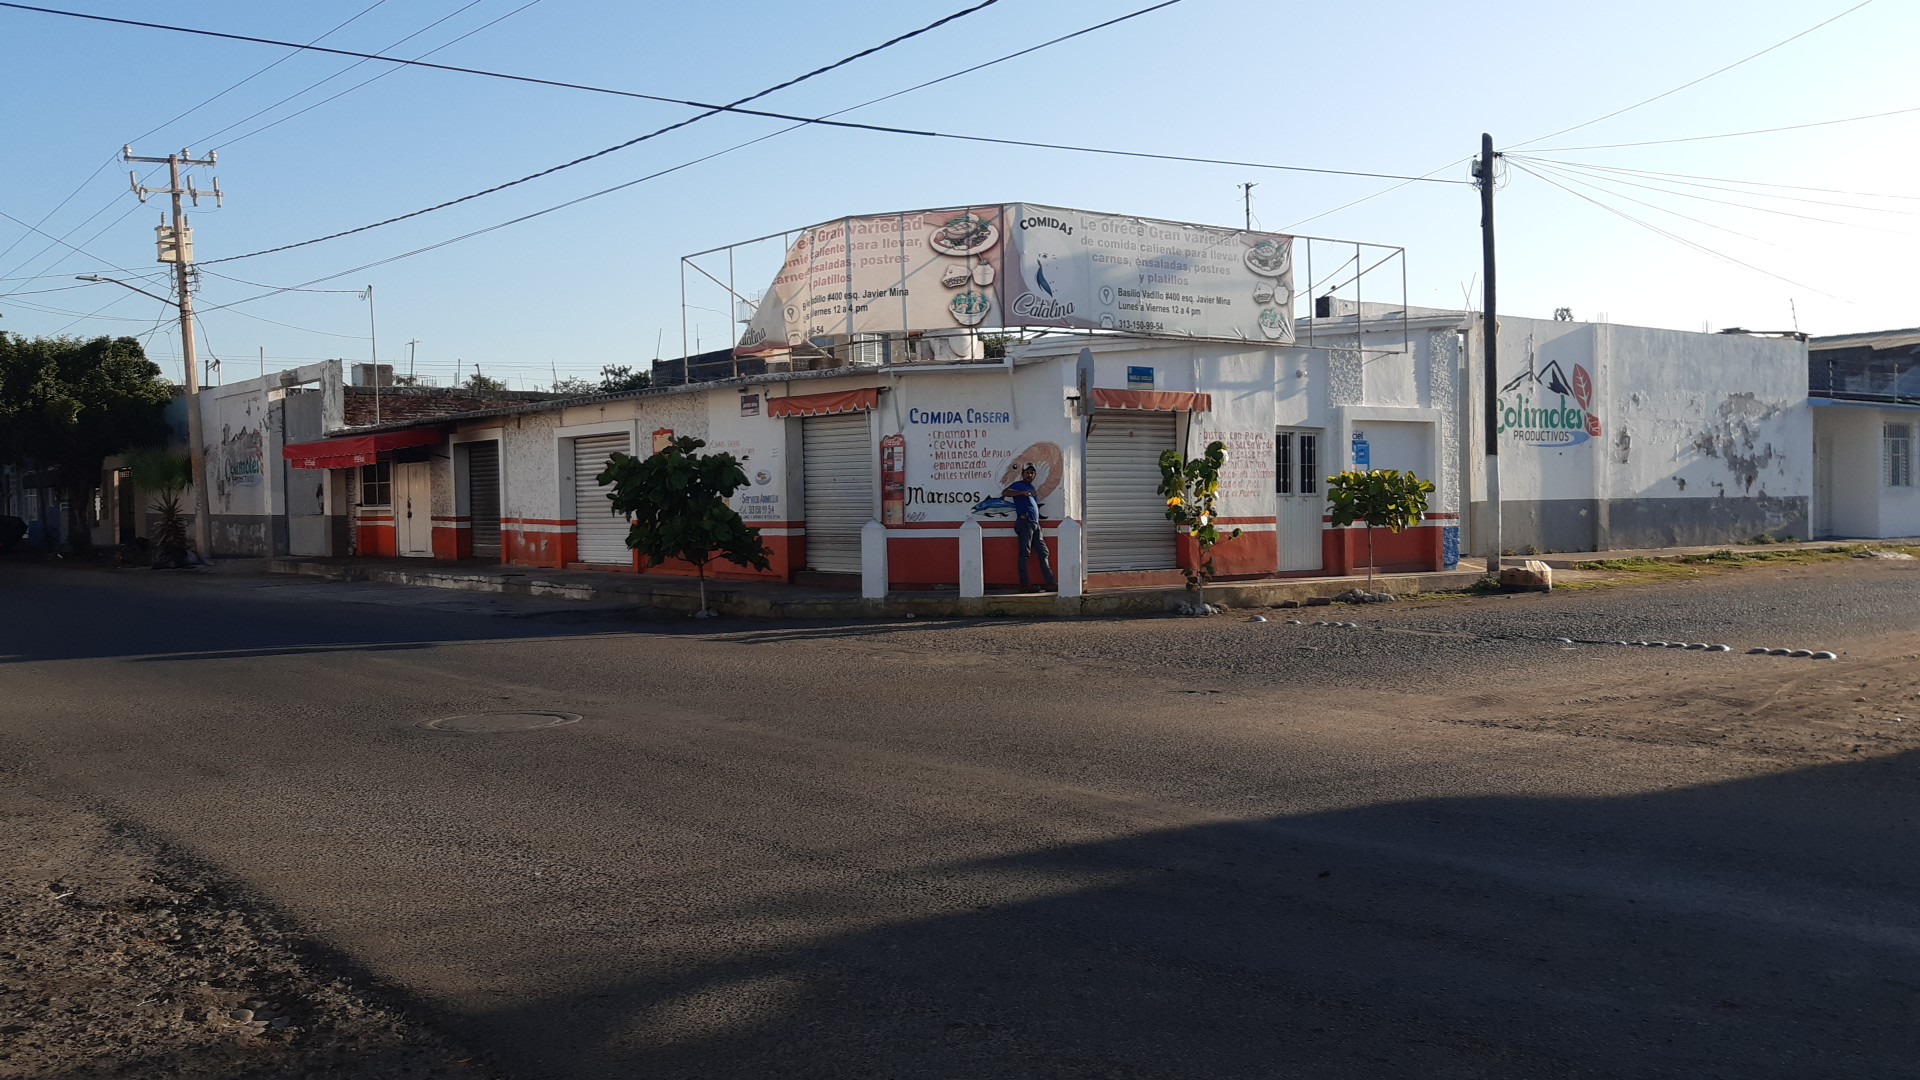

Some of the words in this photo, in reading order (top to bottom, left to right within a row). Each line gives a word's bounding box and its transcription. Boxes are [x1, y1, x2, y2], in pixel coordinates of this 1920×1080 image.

[817, 226, 845, 243] Gran
[848, 215, 924, 236] variedad
[1020, 217, 1073, 235] COMIDAS
[1080, 217, 1097, 231] Le
[1101, 220, 1144, 236] ofrece
[1149, 226, 1181, 242] Gran
[1184, 231, 1240, 248] variedad
[1080, 235, 1094, 246] de
[1097, 237, 1137, 251] comida
[1139, 242, 1186, 256] caliente
[1185, 248, 1208, 259] para
[860, 253, 910, 268] postres
[1091, 252, 1132, 268] carnes,
[1135, 256, 1192, 273] ensaladas,
[1194, 263, 1231, 276] postres
[813, 273, 853, 289] platillos
[1138, 273, 1145, 284] y
[1147, 273, 1189, 286] platillos
[862, 288, 888, 299] Javier
[889, 287, 909, 297] Mina
[1117, 287, 1141, 298] Basilio
[1141, 289, 1164, 300] Vadillo
[1165, 291, 1181, 302] #400
[1195, 294, 1215, 304] Javier
[1216, 296, 1231, 306] Mina
[833, 305, 841, 314] 12
[848, 304, 853, 313] 4
[855, 304, 869, 314] pm
[1013, 293, 1075, 319] Catalina
[1118, 301, 1139, 311] Lunes
[1140, 304, 1145, 312] a
[1145, 303, 1170, 314] Viernes
[1171, 305, 1180, 315] 12
[1185, 306, 1190, 315] 4
[1191, 308, 1201, 317] pm
[1118, 319, 1164, 331] 313-150-99-54
[909, 408, 963, 424] COMIDA
[966, 408, 1010, 424] CASERA
[1513, 430, 1570, 442] PRODUCTIVOS
[981, 447, 991, 458] de
[905, 486, 981, 507] Mariscos
